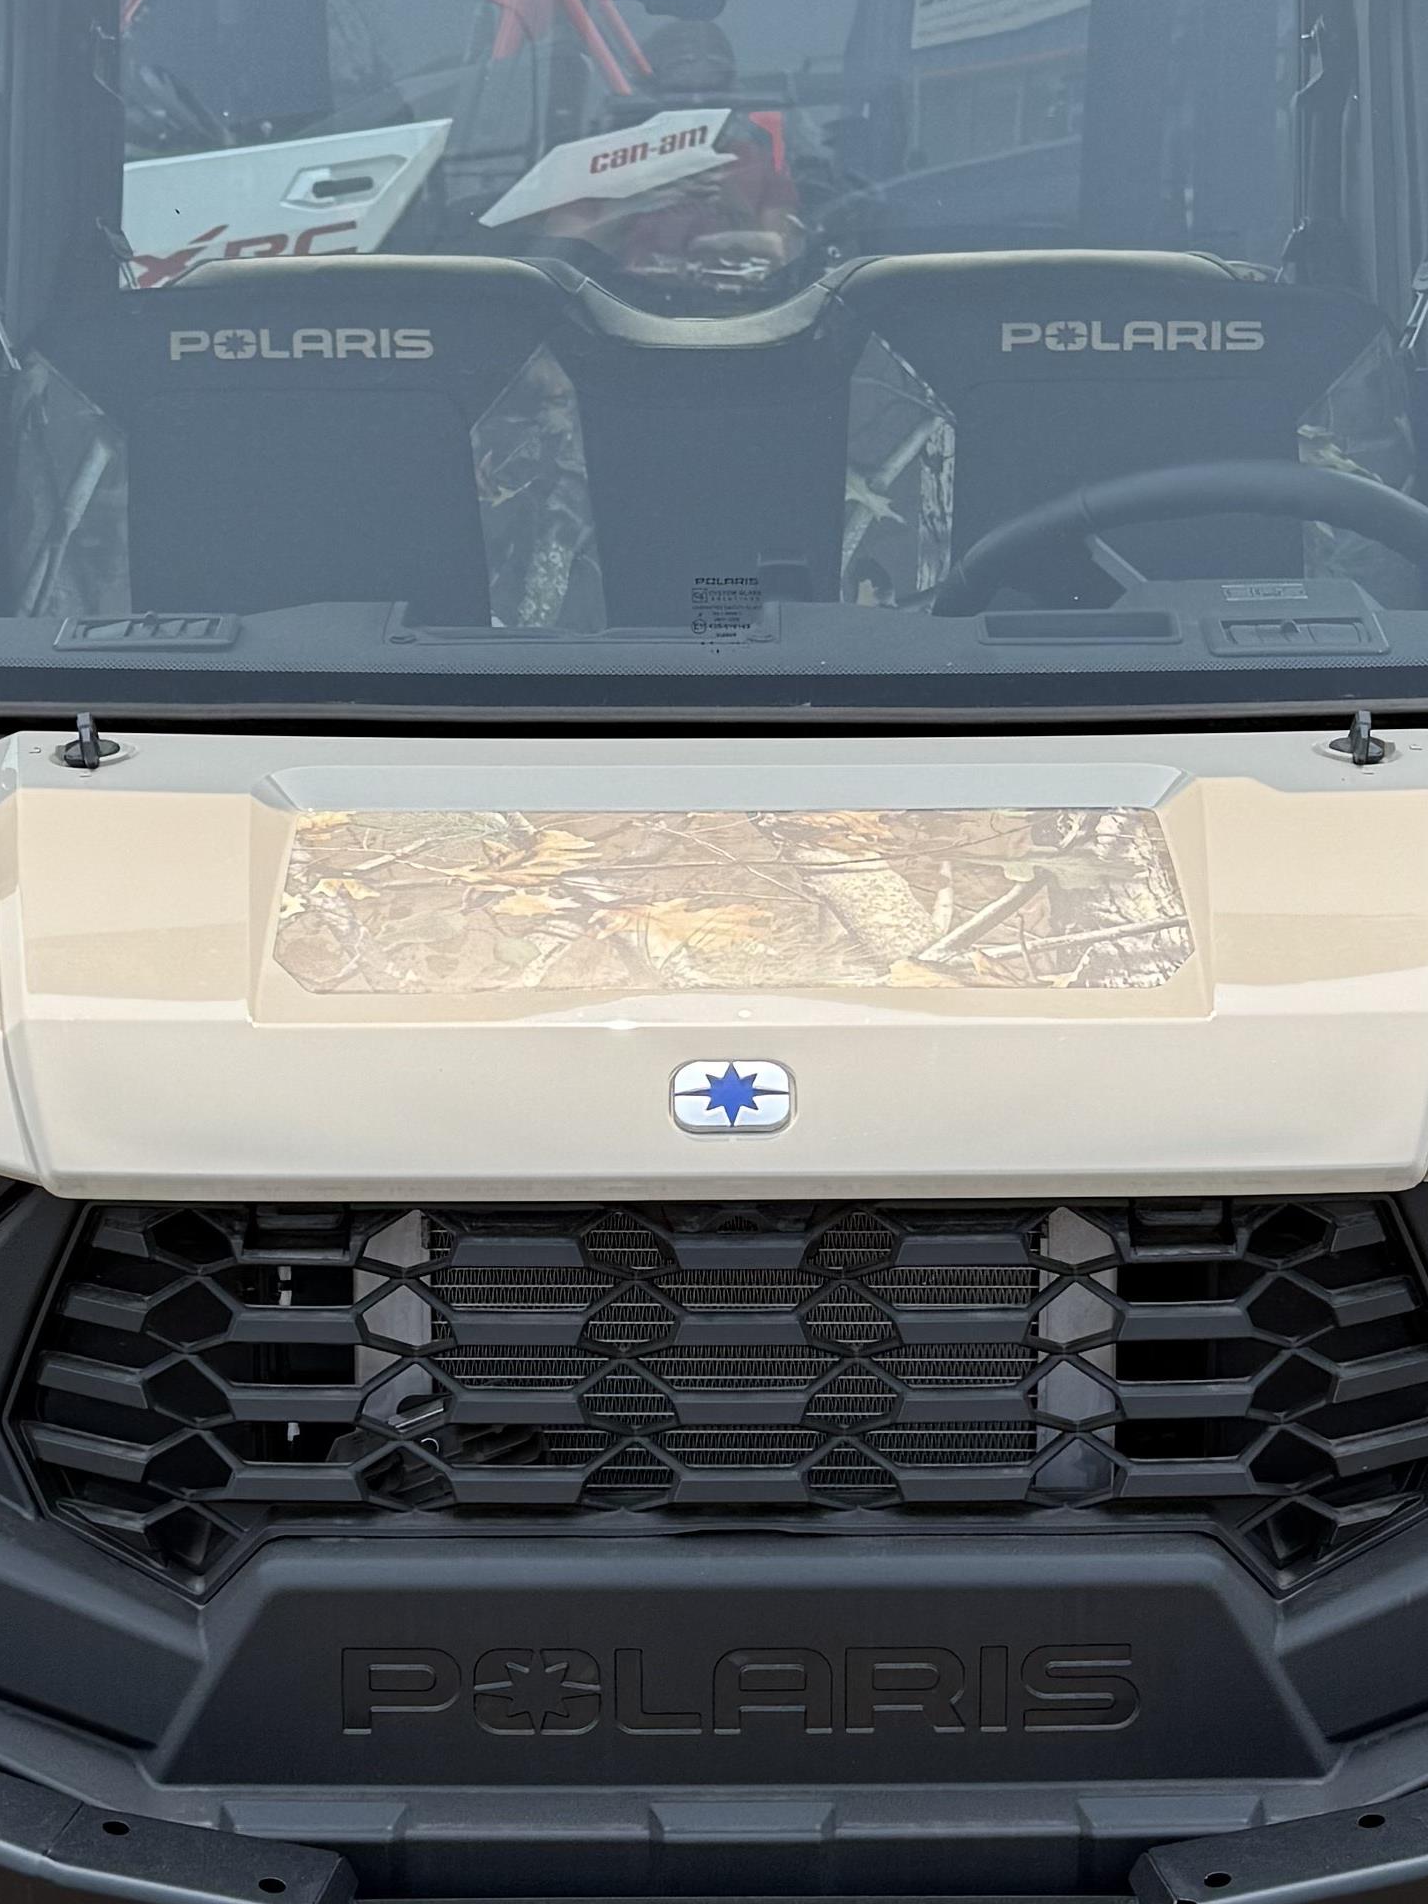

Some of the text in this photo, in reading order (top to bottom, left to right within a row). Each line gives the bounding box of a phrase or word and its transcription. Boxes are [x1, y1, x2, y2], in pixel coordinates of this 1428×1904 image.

[589, 125, 709, 175] can-am
[169, 327, 434, 362] POLARIS
[1000, 319, 1265, 353] POLARIS
[694, 577, 759, 586] POLARIS
[340, 1642, 1142, 1737] POLARIS
